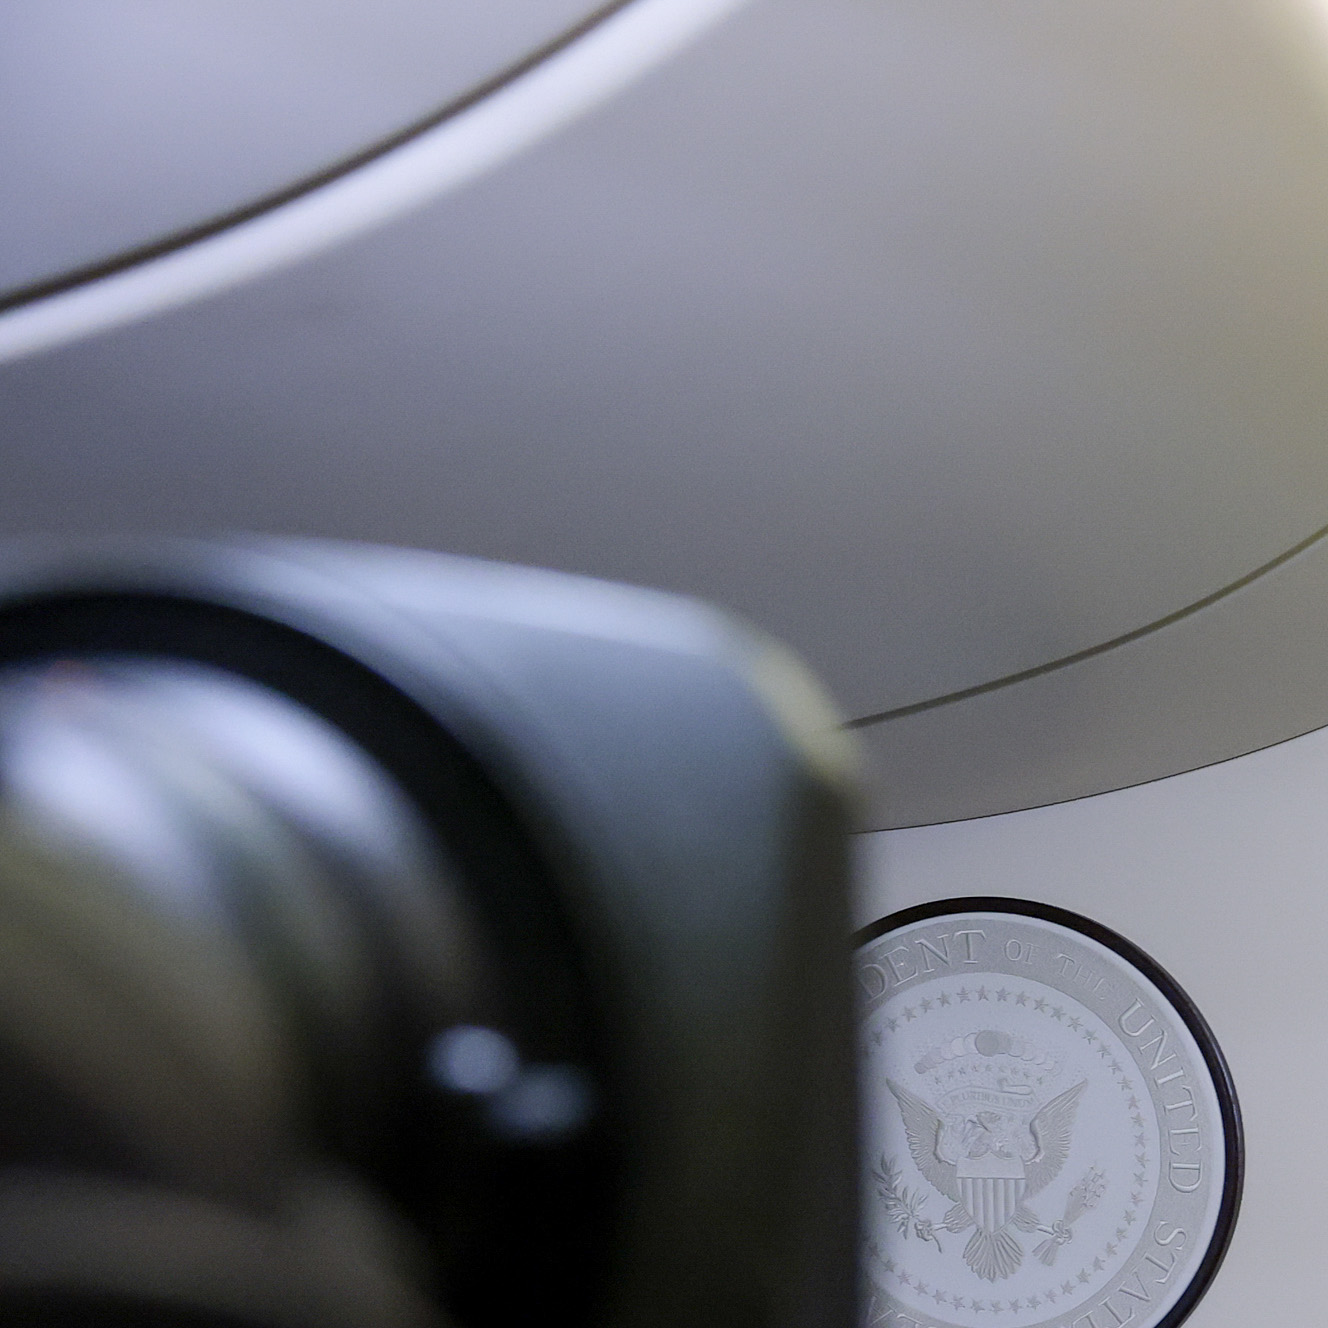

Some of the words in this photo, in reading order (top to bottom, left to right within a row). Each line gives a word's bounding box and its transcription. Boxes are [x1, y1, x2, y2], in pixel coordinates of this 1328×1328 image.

[858, 928, 987, 1003] DENT
[1003, 938, 1040, 965] OF
[1056, 952, 1115, 1001] THE
[1118, 997, 1203, 1194] UNITED
